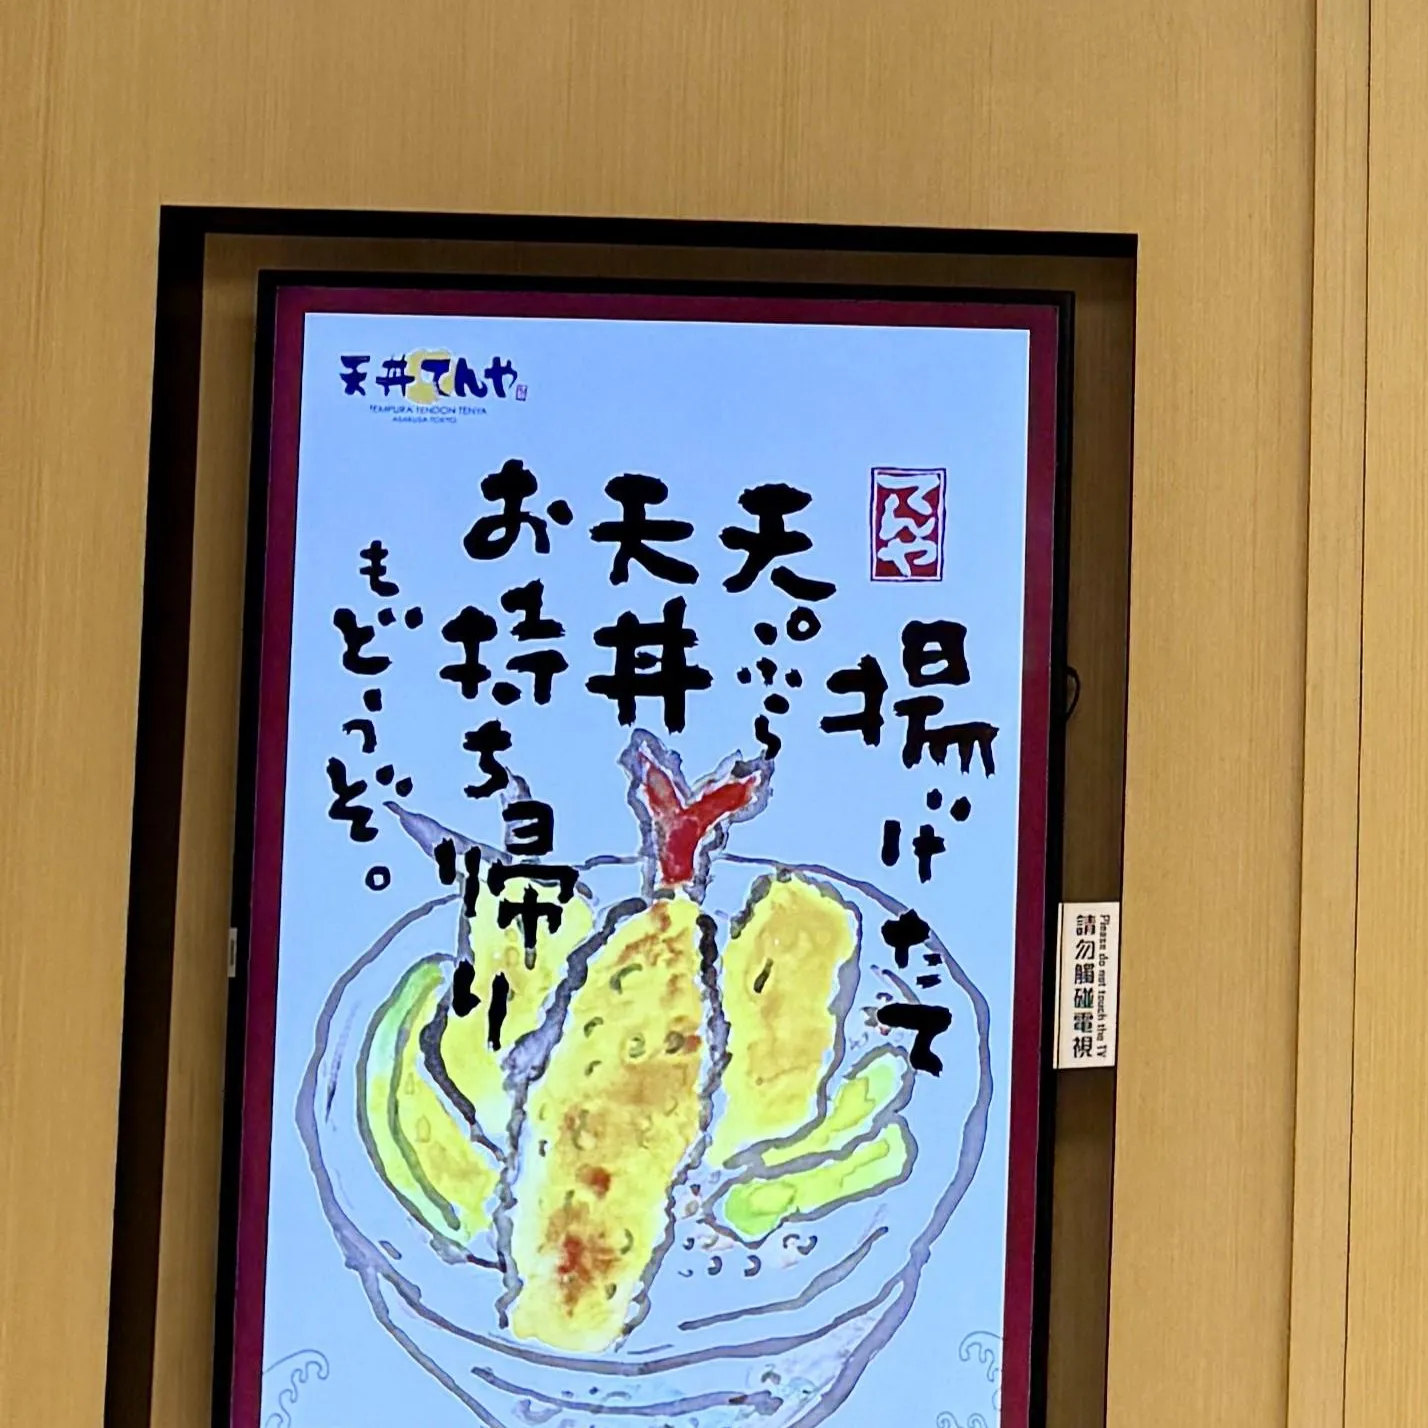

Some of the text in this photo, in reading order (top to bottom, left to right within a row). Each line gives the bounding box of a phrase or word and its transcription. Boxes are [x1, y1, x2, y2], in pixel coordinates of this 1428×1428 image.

[369, 405, 487, 415] TEMPURA TENDON TENYA
[876, 472, 942, 578] てんや
[327, 540, 424, 891] もどうぞ。
[585, 473, 713, 733] 天丼
[719, 483, 836, 760] 天ぷら
[434, 458, 578, 1051] お持ち帰り
[821, 620, 998, 1076] 揚げたて
[1072, 914, 1097, 1059] 請勿觸碰電視
[1096, 914, 1111, 1058] Please do not touch the TV
